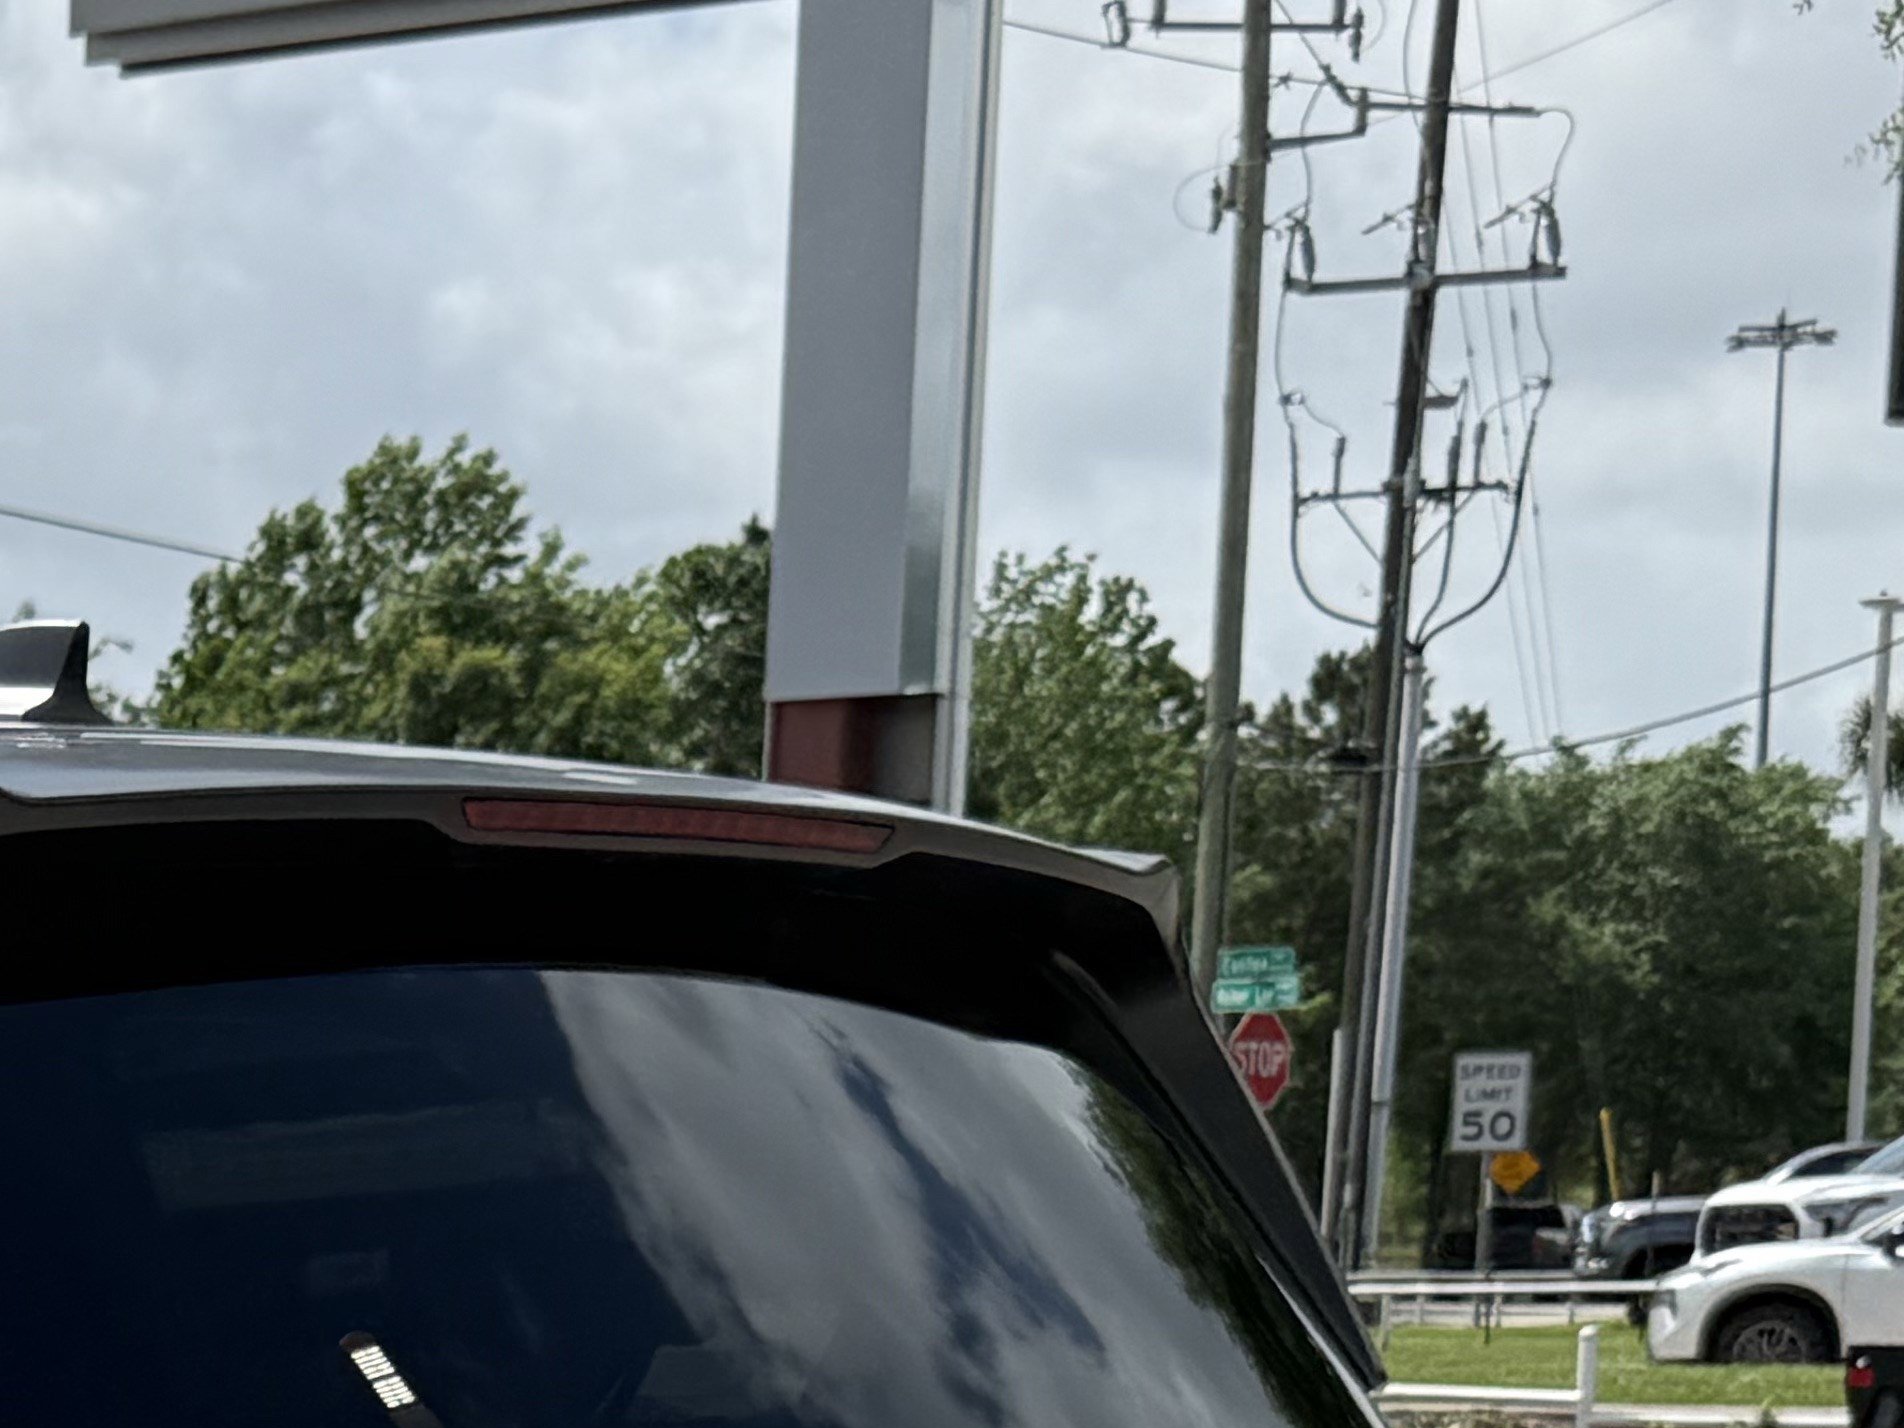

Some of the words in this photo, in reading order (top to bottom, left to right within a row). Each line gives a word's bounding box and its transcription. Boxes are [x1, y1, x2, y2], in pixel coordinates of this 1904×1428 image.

[1234, 1041, 1287, 1077] STOP
[1460, 1064, 1521, 1080] SPEED
[1464, 1086, 1513, 1102] LIMIT
[1460, 1111, 1516, 1142] 50
